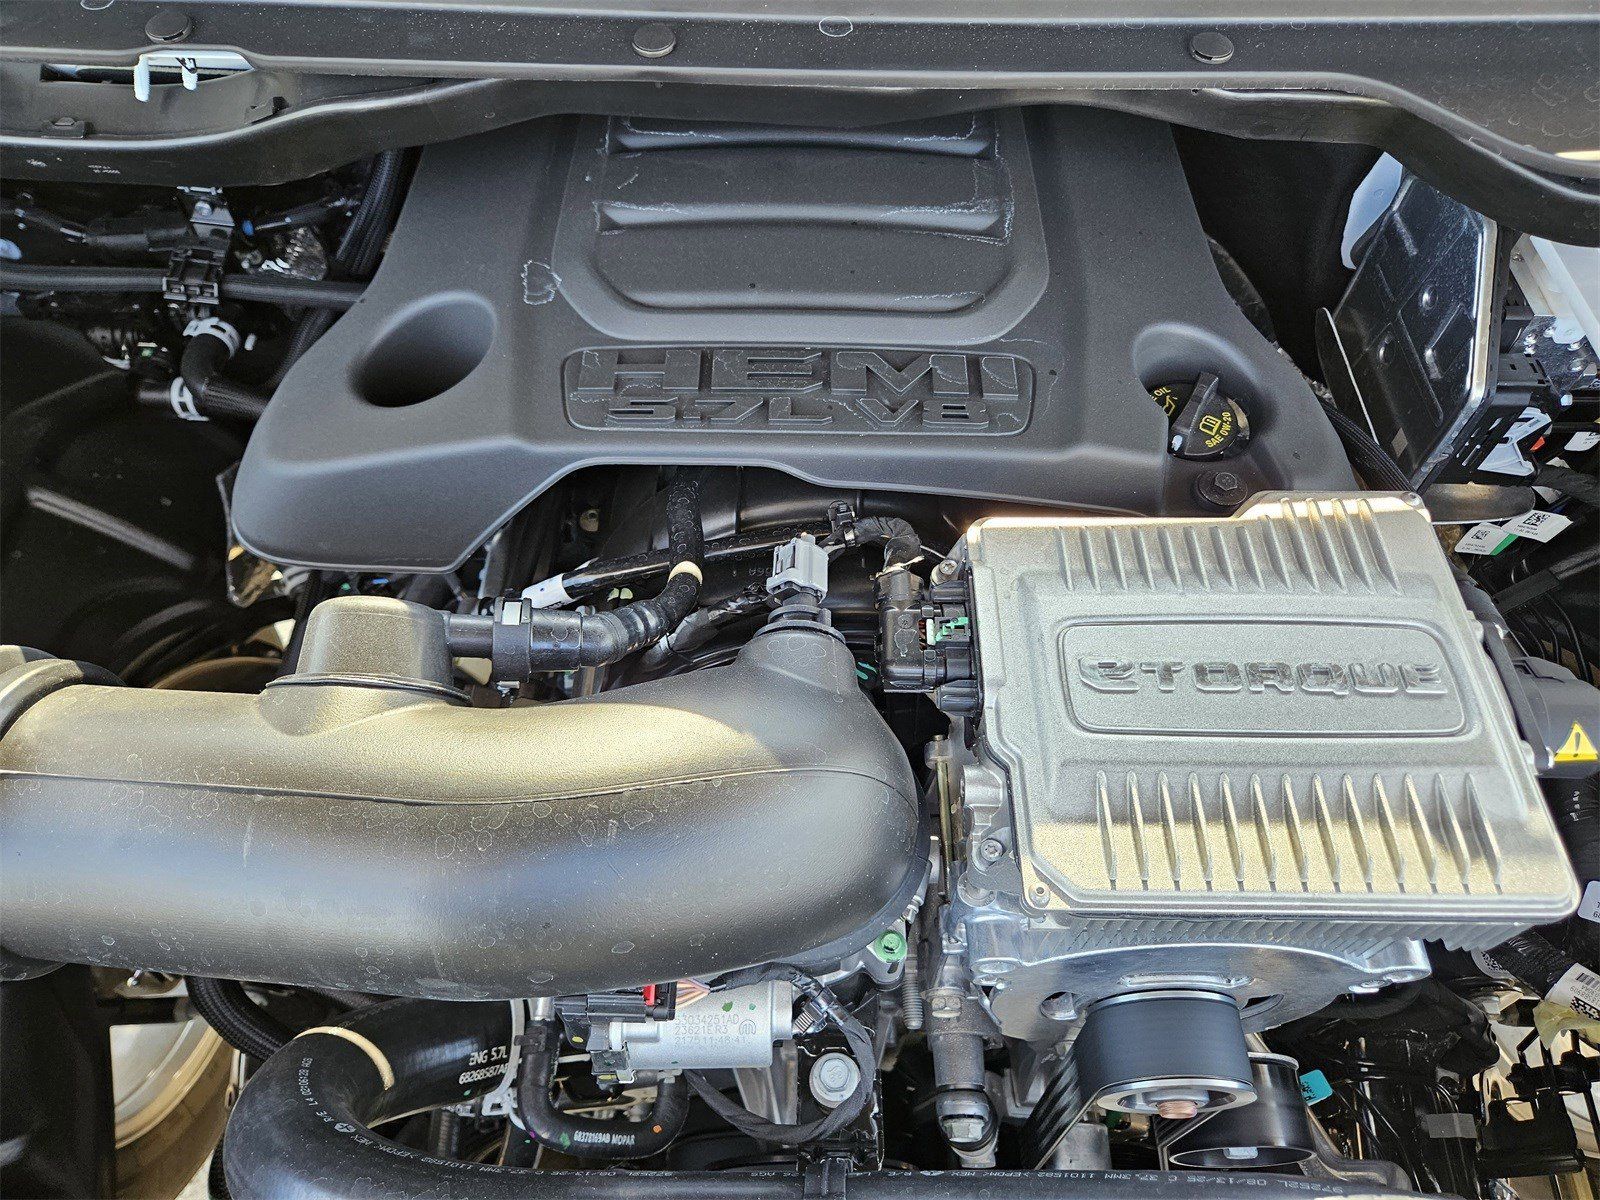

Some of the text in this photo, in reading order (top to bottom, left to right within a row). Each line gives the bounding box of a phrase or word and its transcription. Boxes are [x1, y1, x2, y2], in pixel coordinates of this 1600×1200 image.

[576, 348, 1020, 399] HEMI
[1154, 387, 1171, 397] OIL
[857, 397, 990, 429] V8
[1205, 411, 1232, 448] SAE 0W-20
[469, 1050, 488, 1066] ENG
[611, 1133, 636, 1146] MOPAR
[1186, 1175, 1267, 1187] 08/13/25
[1277, 1179, 1344, 1195] 97252L
